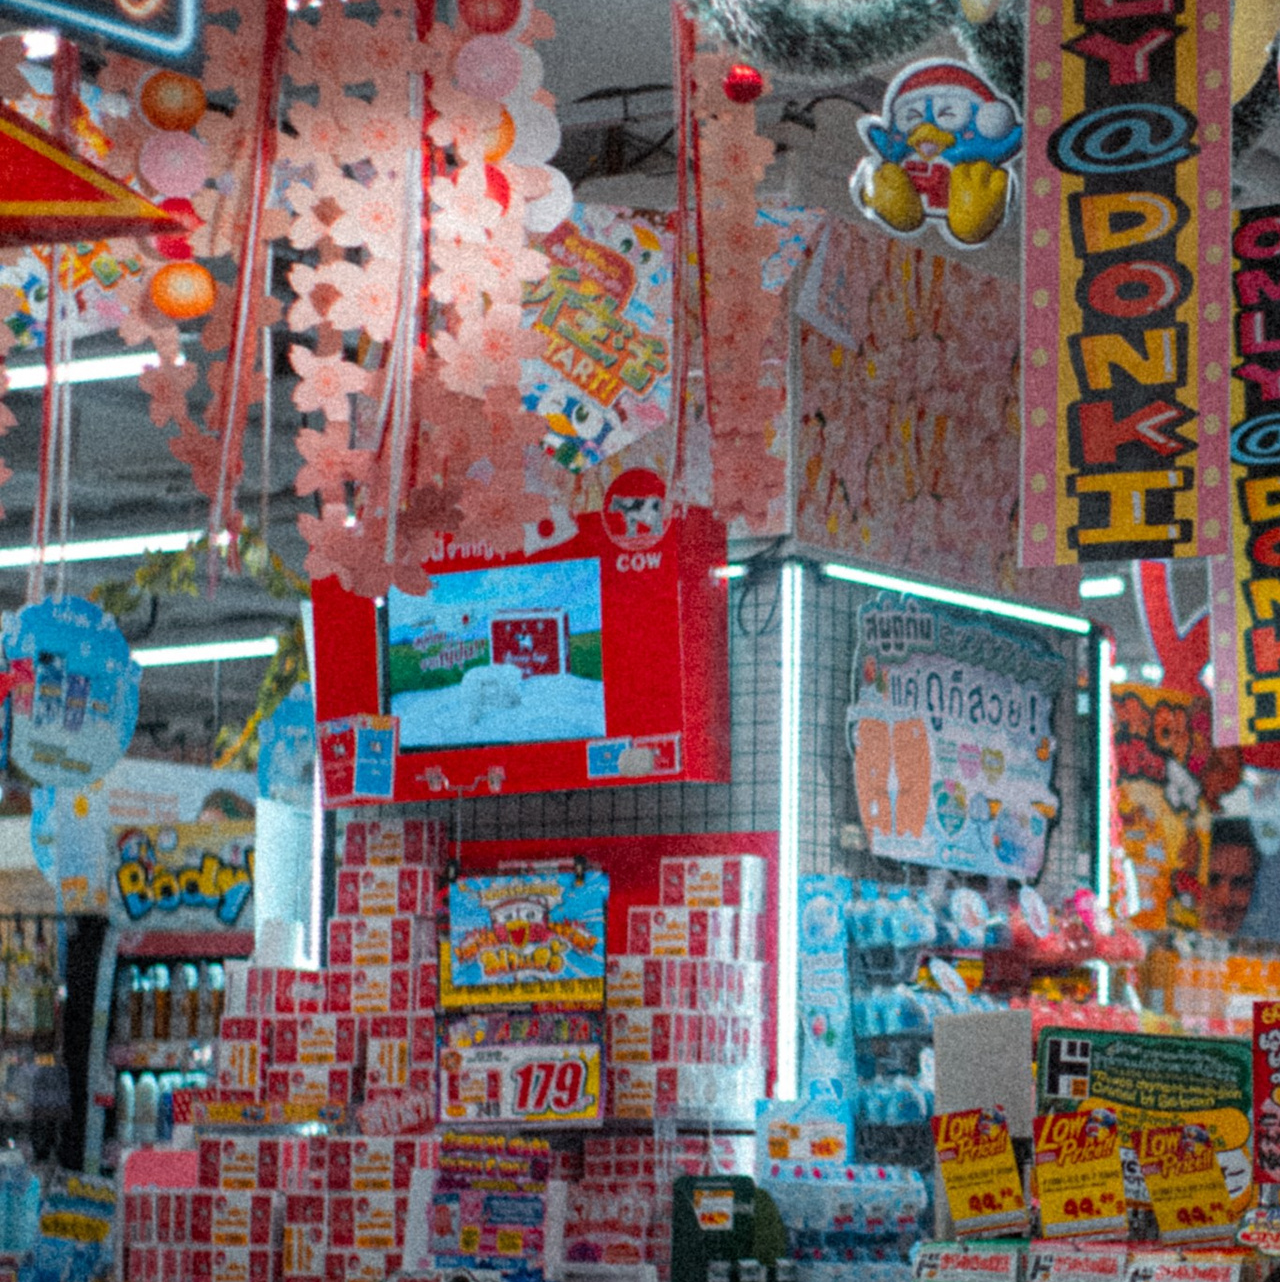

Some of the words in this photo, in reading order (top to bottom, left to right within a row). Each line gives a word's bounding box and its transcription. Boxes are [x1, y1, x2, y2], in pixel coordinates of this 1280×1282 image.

[615, 551, 663, 573] COW
[513, 1060, 587, 1114] 179
[937, 1113, 979, 1149] Low
[1038, 1120, 1085, 1152] Low
[1139, 1128, 1181, 1163] Low
